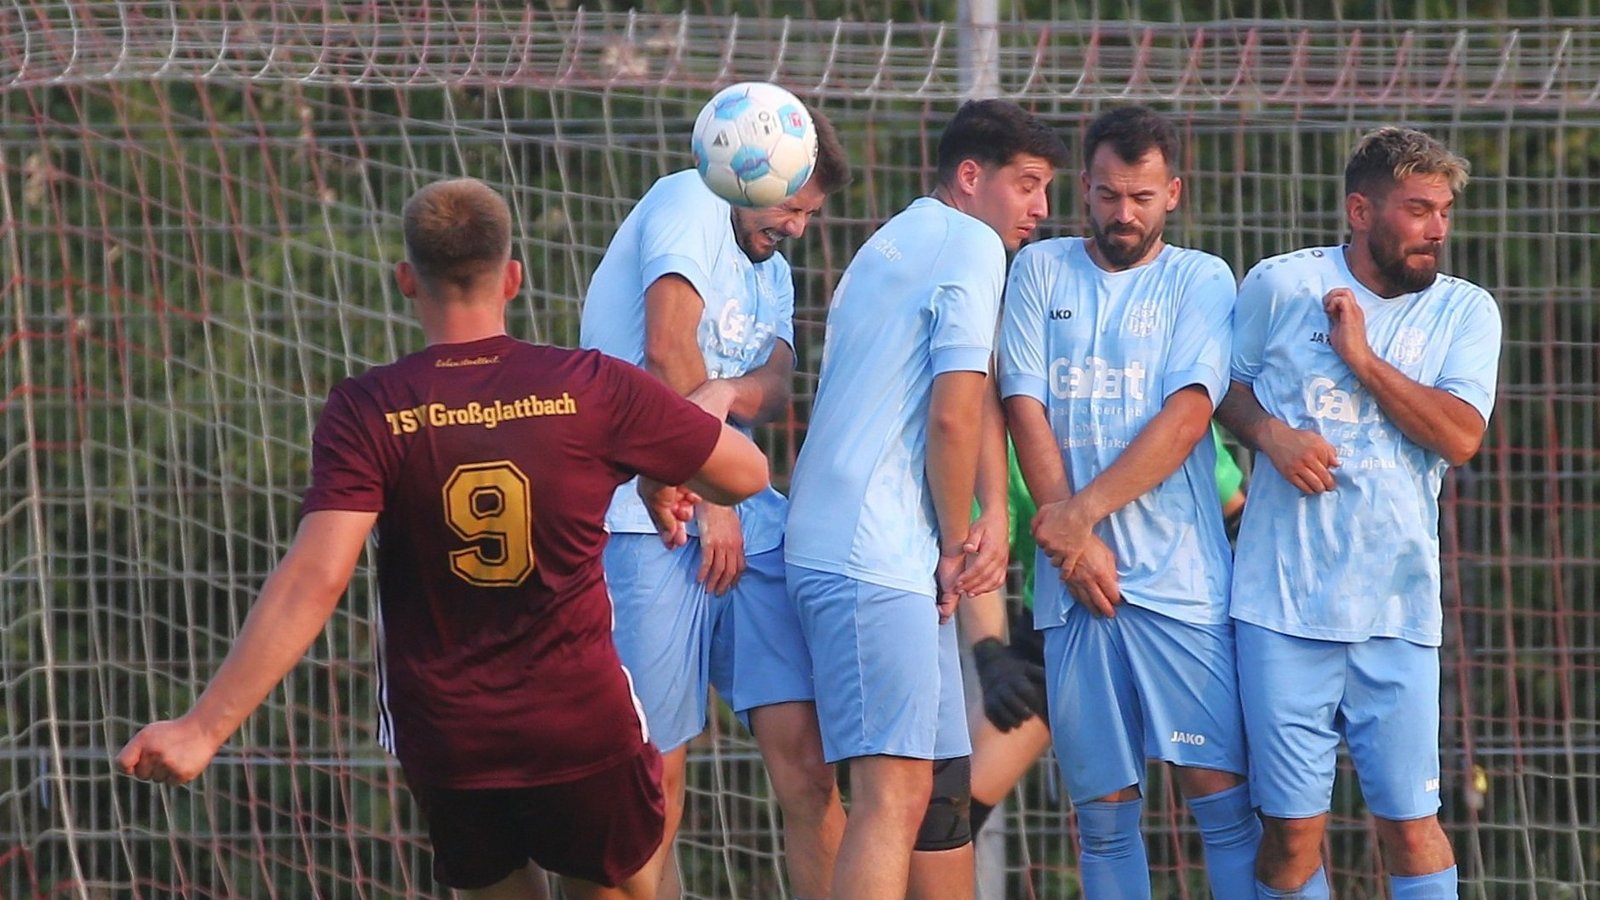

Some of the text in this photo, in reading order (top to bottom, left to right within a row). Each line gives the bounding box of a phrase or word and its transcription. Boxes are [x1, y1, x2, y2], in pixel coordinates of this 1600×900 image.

[1049, 309, 1072, 320] AKO
[385, 392, 577, 435] TSV Großglattbach
[442, 460, 534, 587] 9
[1171, 731, 1205, 746] JAKO
